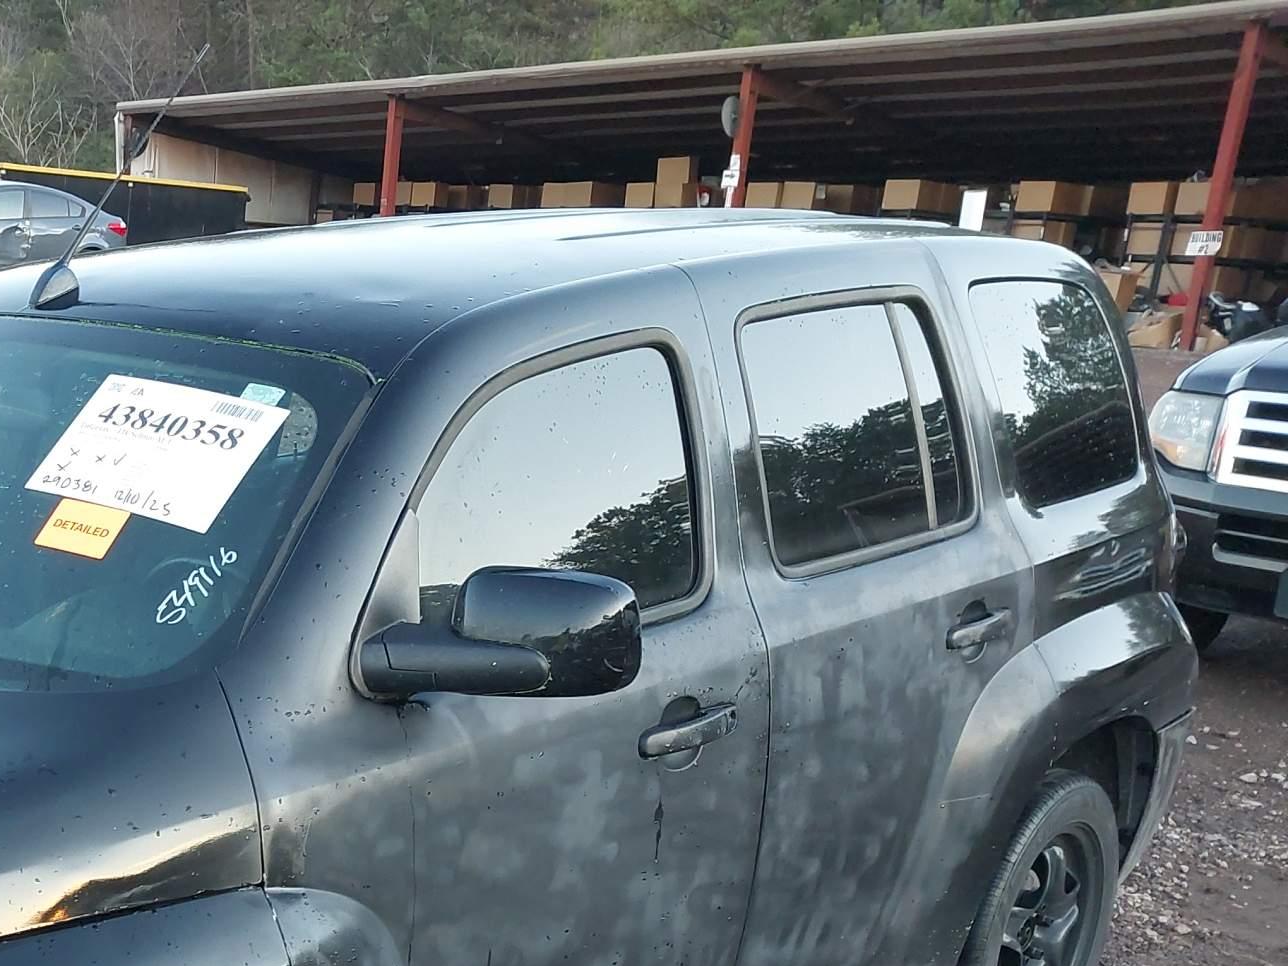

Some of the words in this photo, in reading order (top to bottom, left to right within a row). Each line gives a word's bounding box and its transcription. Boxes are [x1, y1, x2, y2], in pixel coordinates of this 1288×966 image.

[1192, 233, 1222, 242] BUILDING
[98, 403, 245, 451] 43840358
[42, 475, 98, 495] 290381
[53, 518, 110, 539] DETAILED
